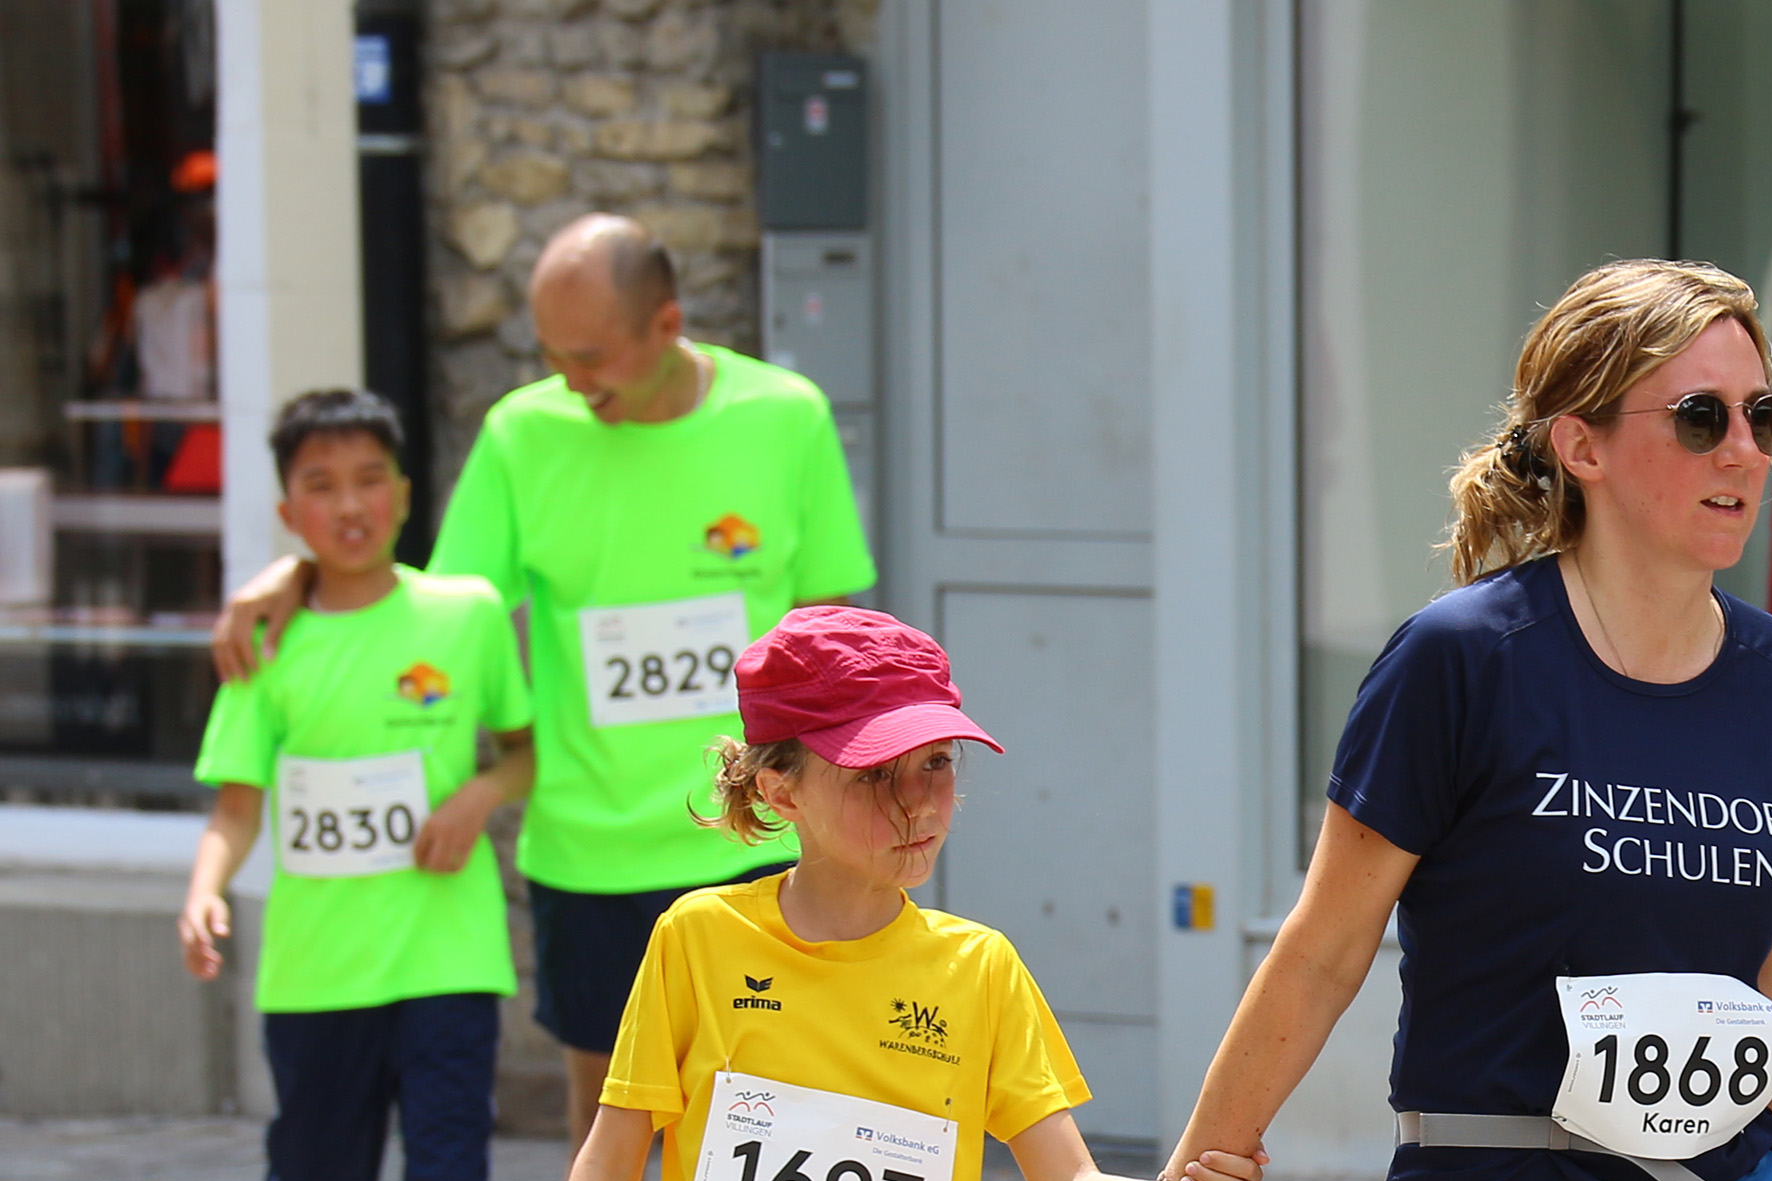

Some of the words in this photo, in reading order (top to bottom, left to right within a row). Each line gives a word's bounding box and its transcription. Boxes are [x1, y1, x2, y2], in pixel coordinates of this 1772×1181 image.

[605, 644, 735, 699] 2829
[290, 803, 415, 852] 2830
[733, 996, 782, 1012] erima
[1716, 1001, 1764, 1012] Volksbank
[1581, 1014, 1625, 1022] STADTLAUF
[1583, 1021, 1626, 1030] VILLINGEN
[879, 1039, 961, 1066] WARENBERGSCHULE
[1594, 1034, 1769, 1107] 1868
[726, 1121, 772, 1138] VILLINGEN
[727, 1113, 774, 1129] STADTLAUF
[1642, 1112, 1710, 1135] Karen
[876, 1131, 926, 1152] Volksbank
[927, 1143, 940, 1156] eG
